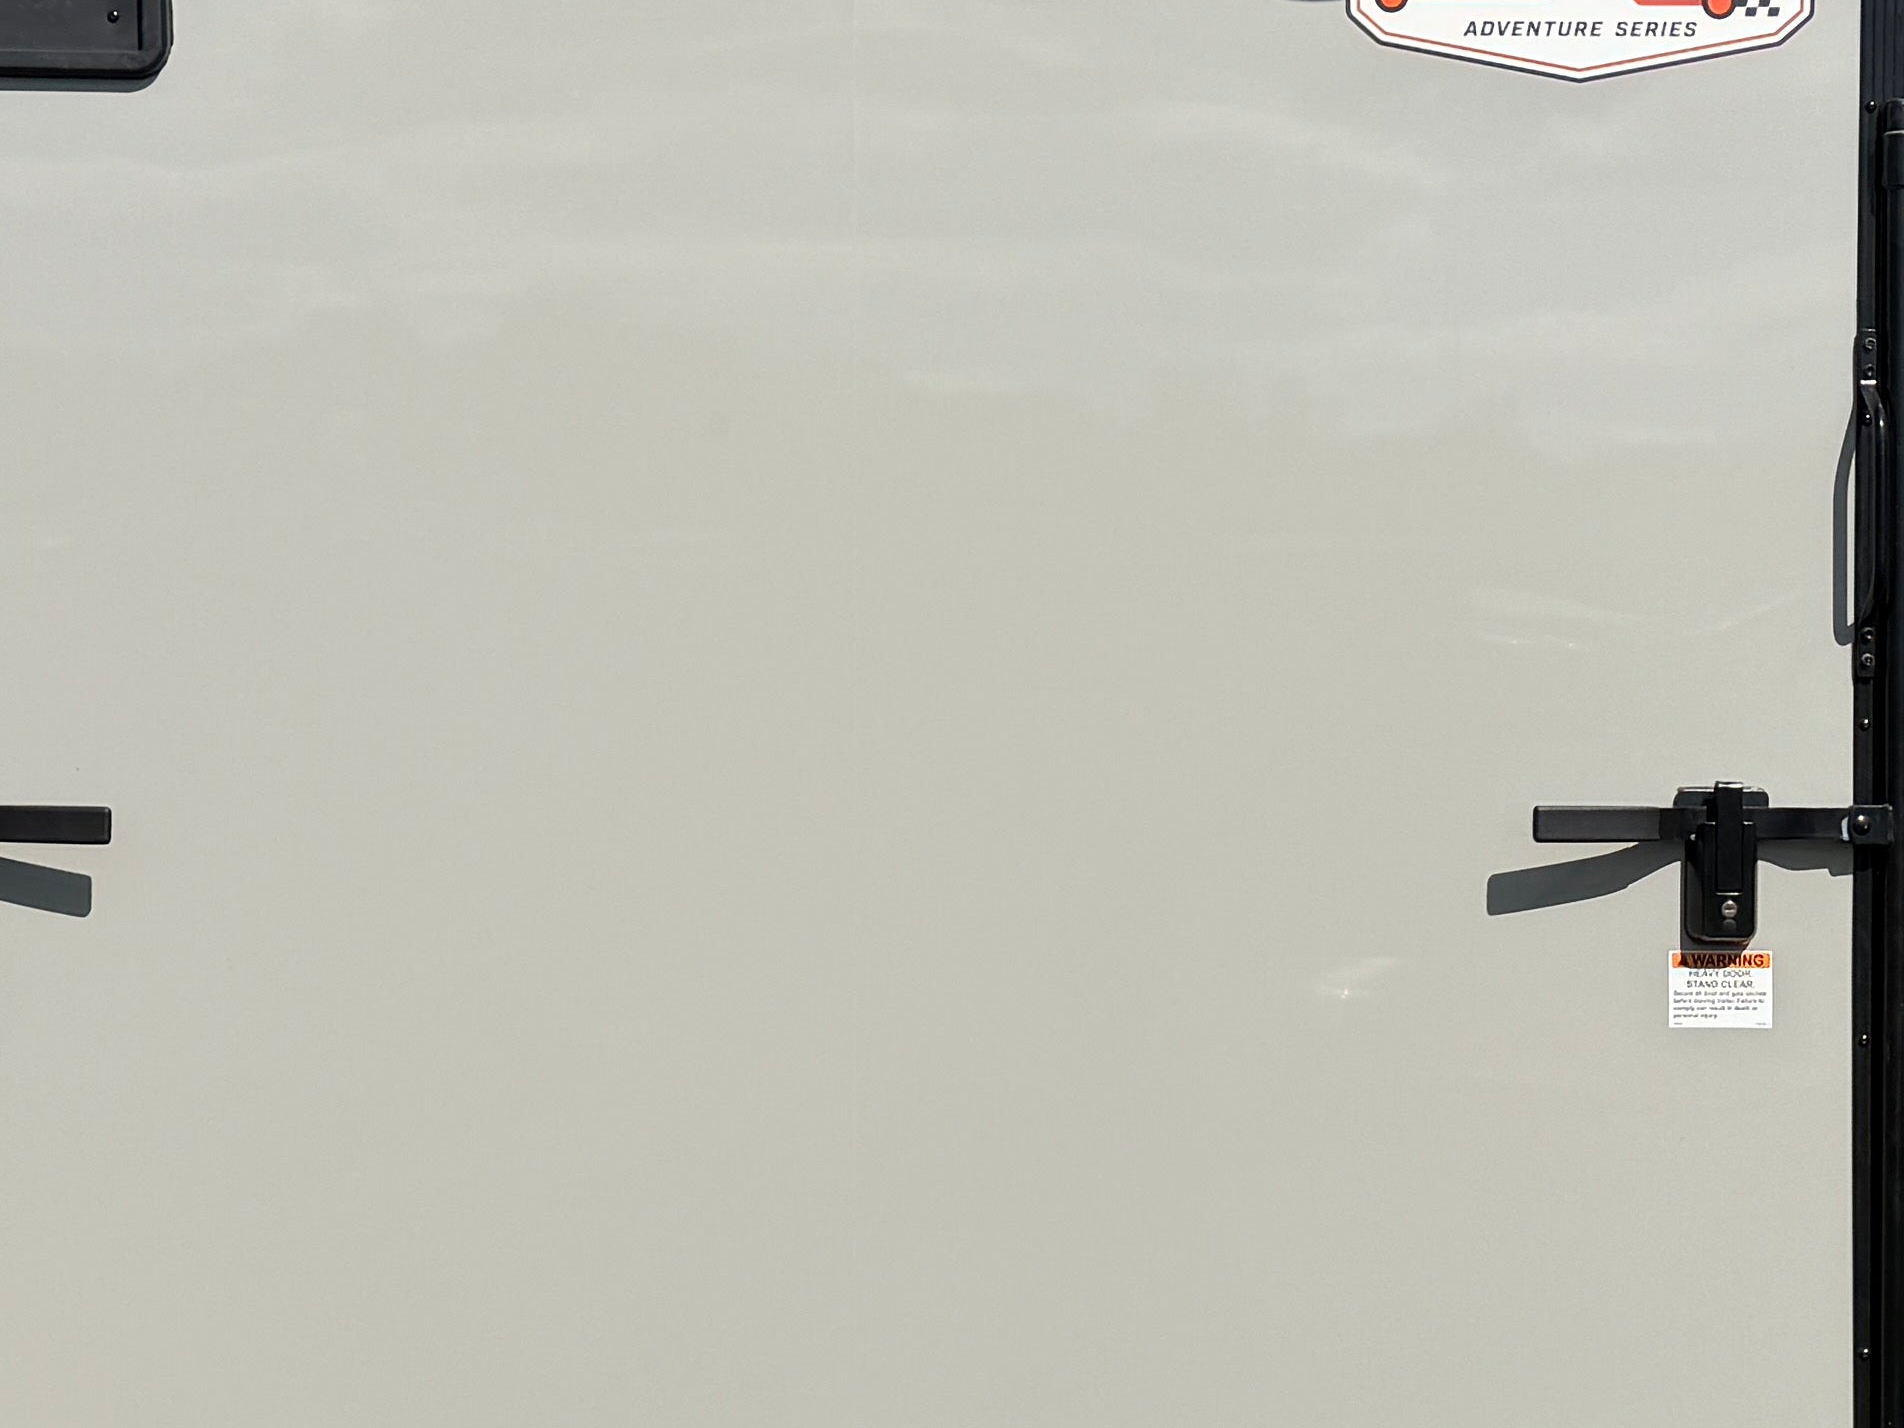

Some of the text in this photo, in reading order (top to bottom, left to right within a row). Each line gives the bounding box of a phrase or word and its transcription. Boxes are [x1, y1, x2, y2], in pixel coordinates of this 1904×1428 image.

[1463, 20, 1698, 38] ADVENTURE SERIES
[1692, 954, 1764, 968] WARNING
[1686, 980, 1718, 988] STAND
